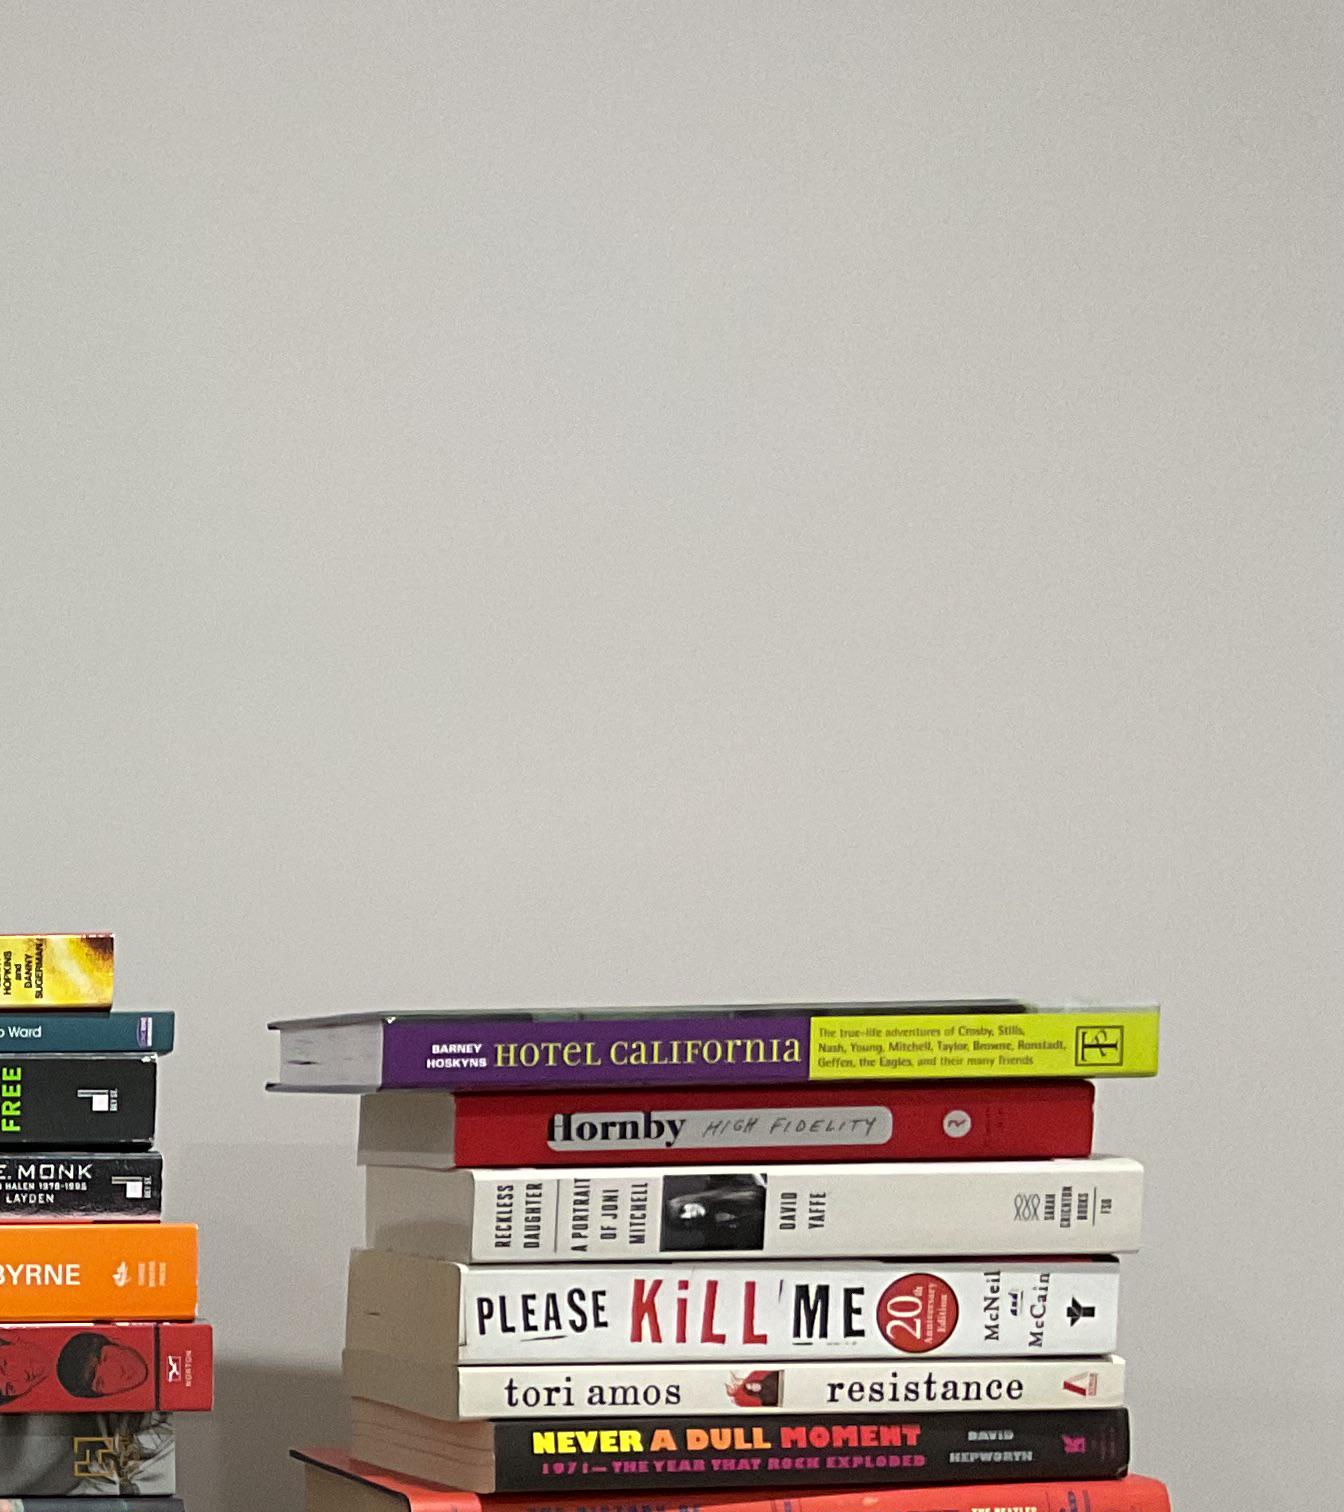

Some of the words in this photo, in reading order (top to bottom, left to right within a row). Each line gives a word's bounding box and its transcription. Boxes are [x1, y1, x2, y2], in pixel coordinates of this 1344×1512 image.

[12, 1025, 42, 1038] Ward
[506, 1380, 576, 1406] tori
[589, 1384, 681, 1405] amos
[828, 1376, 1024, 1404] resistance
[533, 1429, 643, 1454] NEVER
[650, 1429, 677, 1451] A
[685, 1428, 771, 1451] DULL
[781, 1425, 921, 1448] MOMENT
